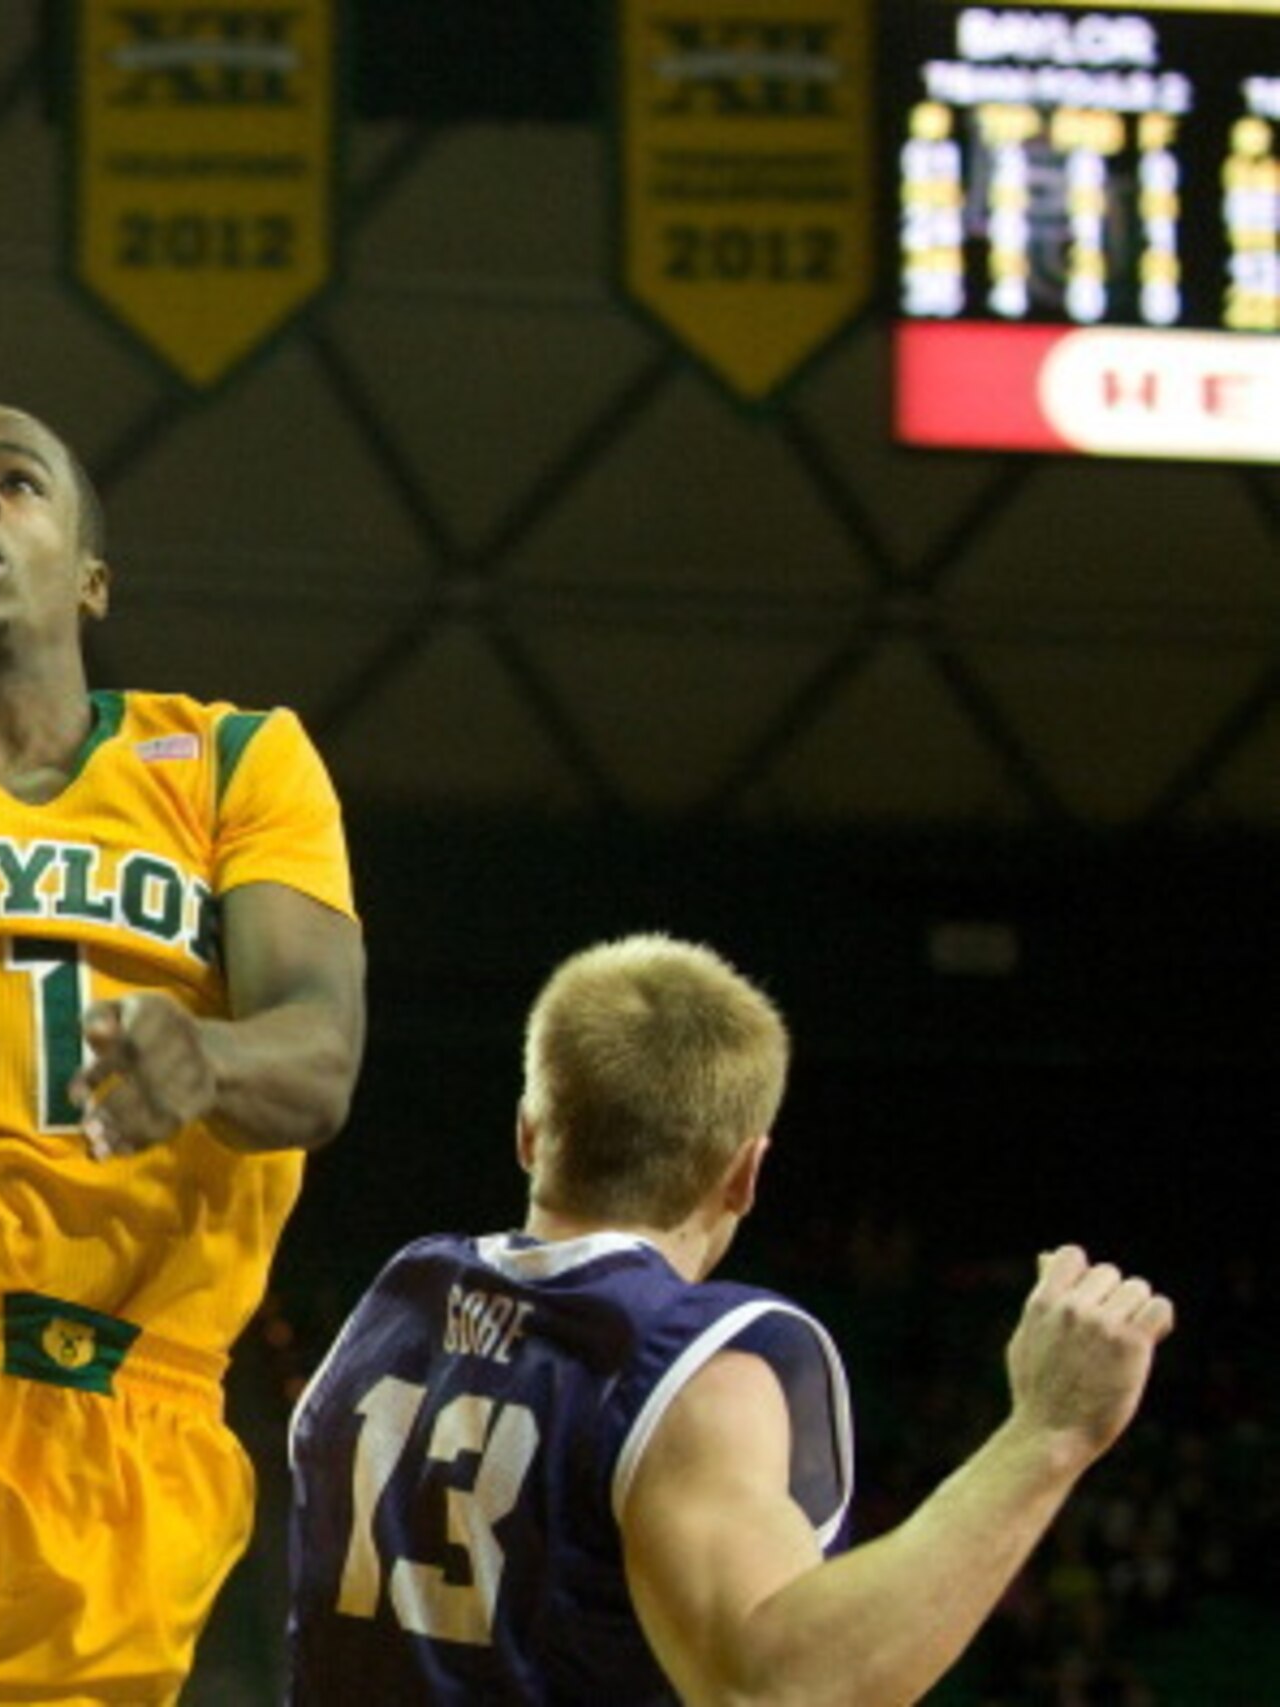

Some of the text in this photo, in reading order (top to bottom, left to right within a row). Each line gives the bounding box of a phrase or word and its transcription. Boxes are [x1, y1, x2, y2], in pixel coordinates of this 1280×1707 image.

[116, 211, 297, 270] 2012
[663, 223, 841, 284] 2012
[4, 932, 102, 1136] 1
[334, 1374, 540, 1648] 13
